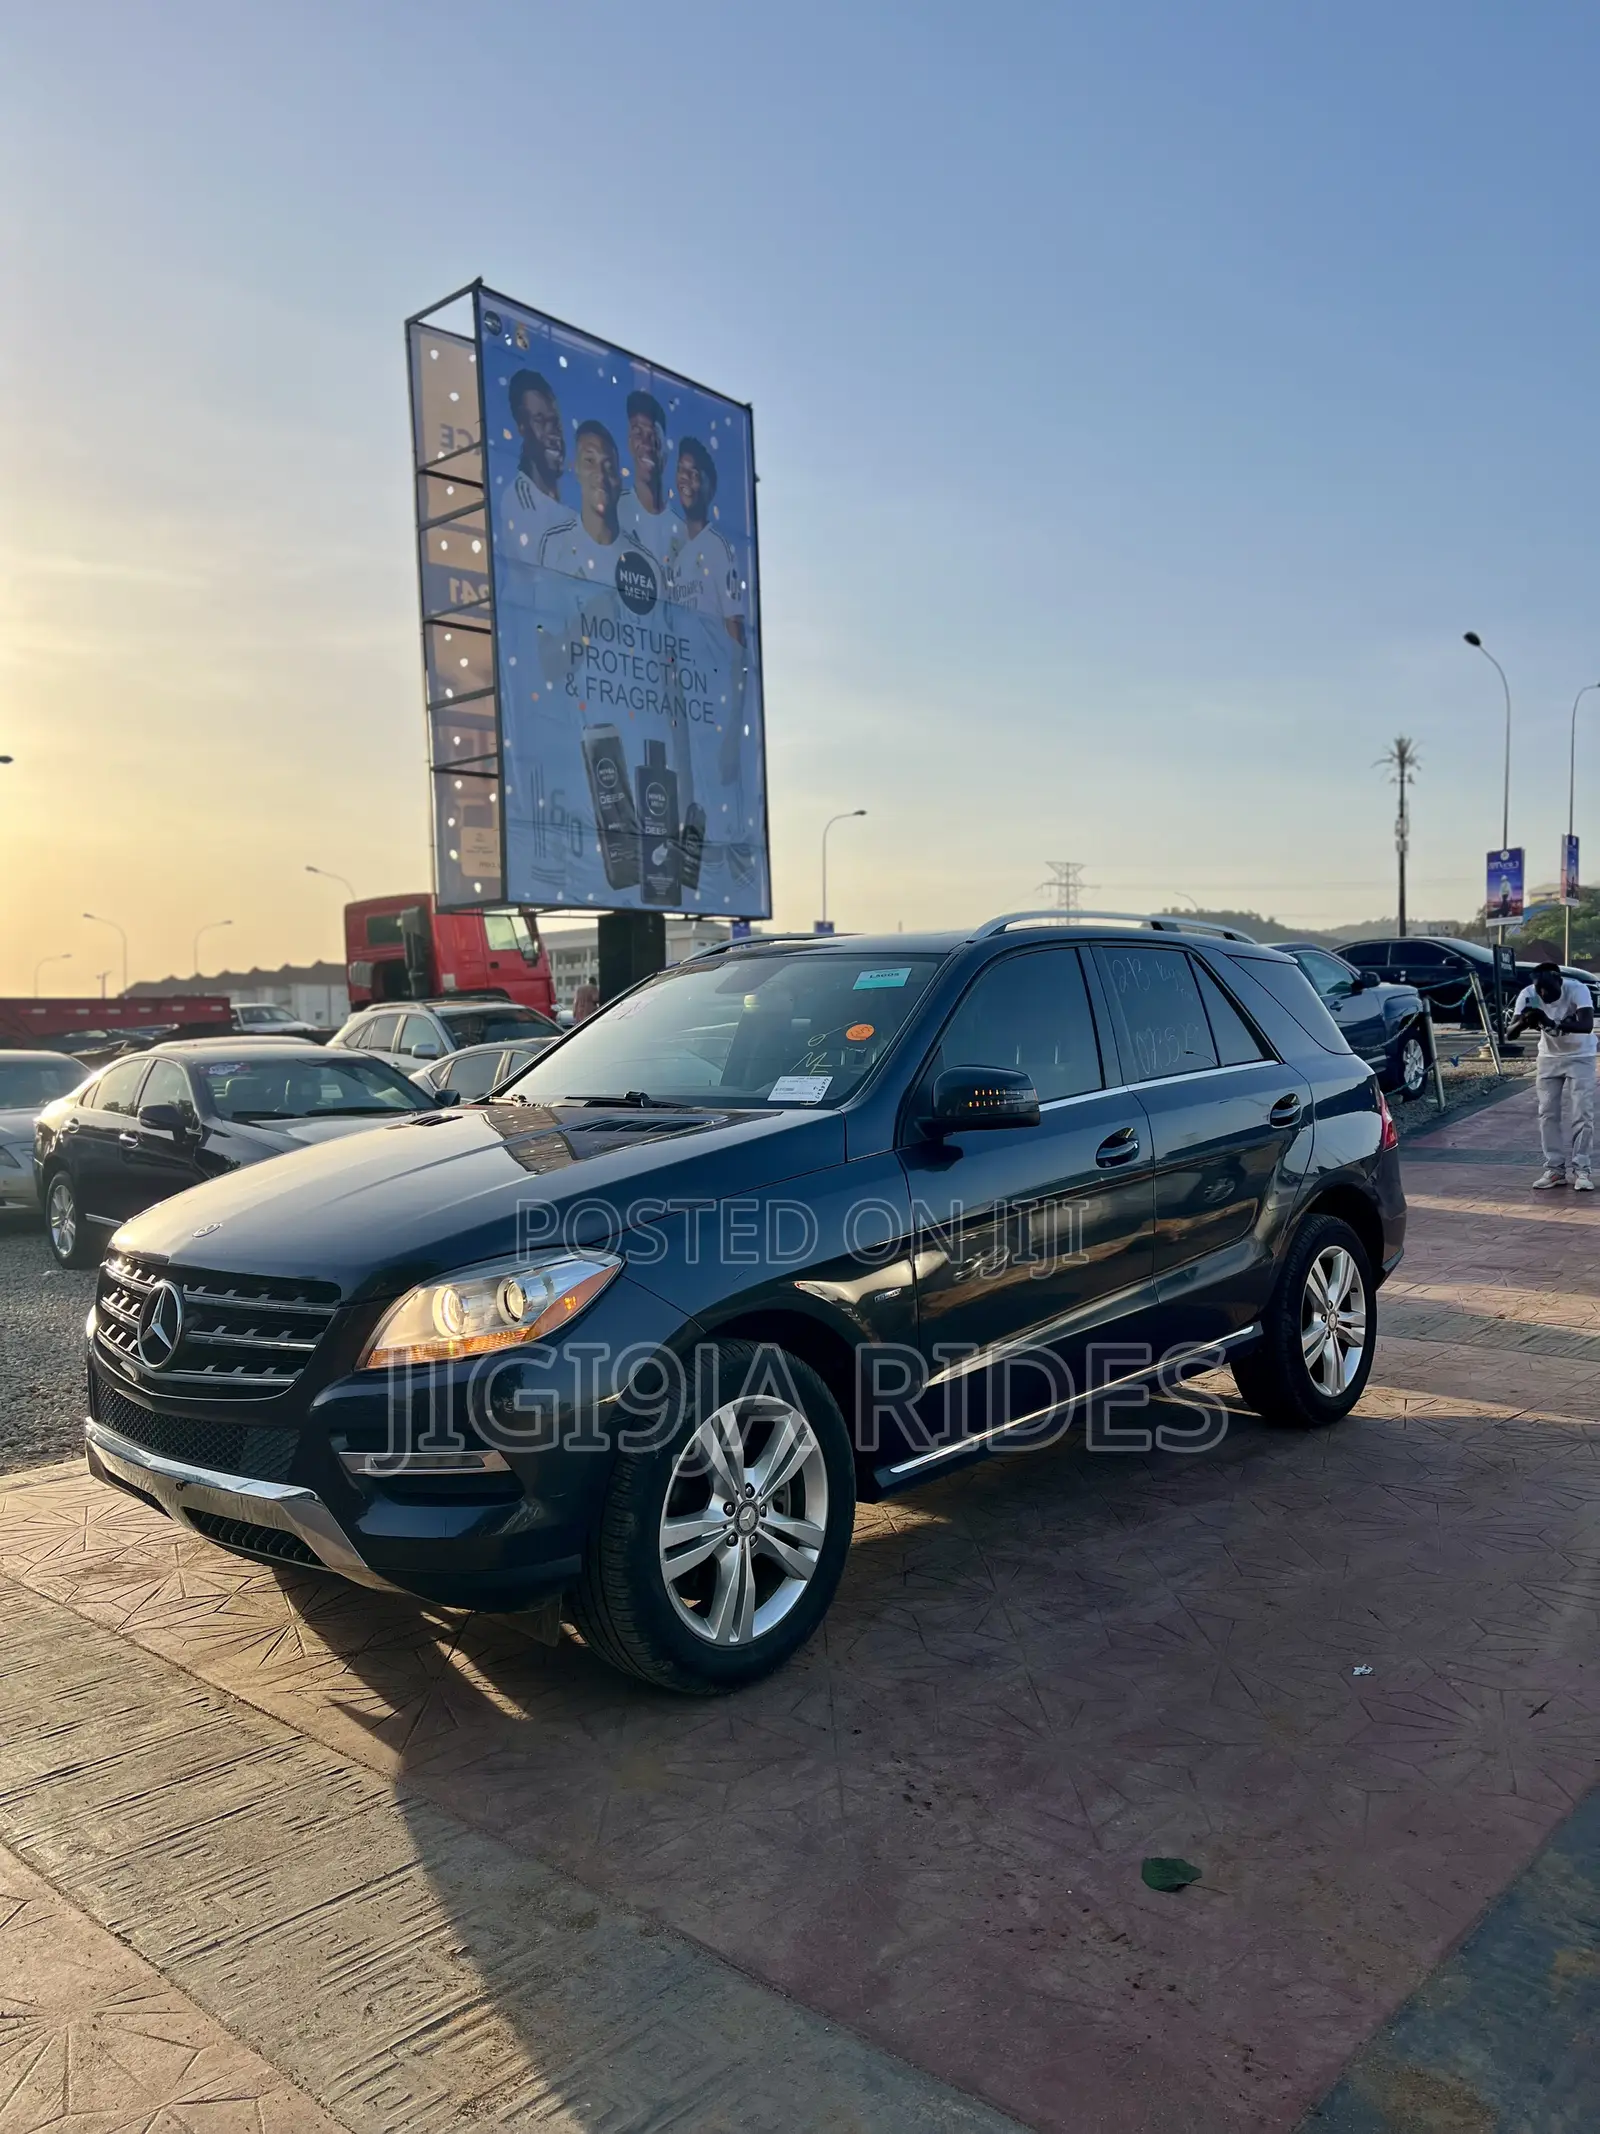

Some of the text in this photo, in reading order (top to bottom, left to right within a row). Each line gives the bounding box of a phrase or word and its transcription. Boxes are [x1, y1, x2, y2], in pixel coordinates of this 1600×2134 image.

[620, 569, 654, 590] NIVEA
[625, 585, 650, 601] MEN
[580, 612, 696, 666] MOISTURE,
[570, 641, 708, 695] PROTECTION
[565, 672, 715, 725] & FRAGRANCE
